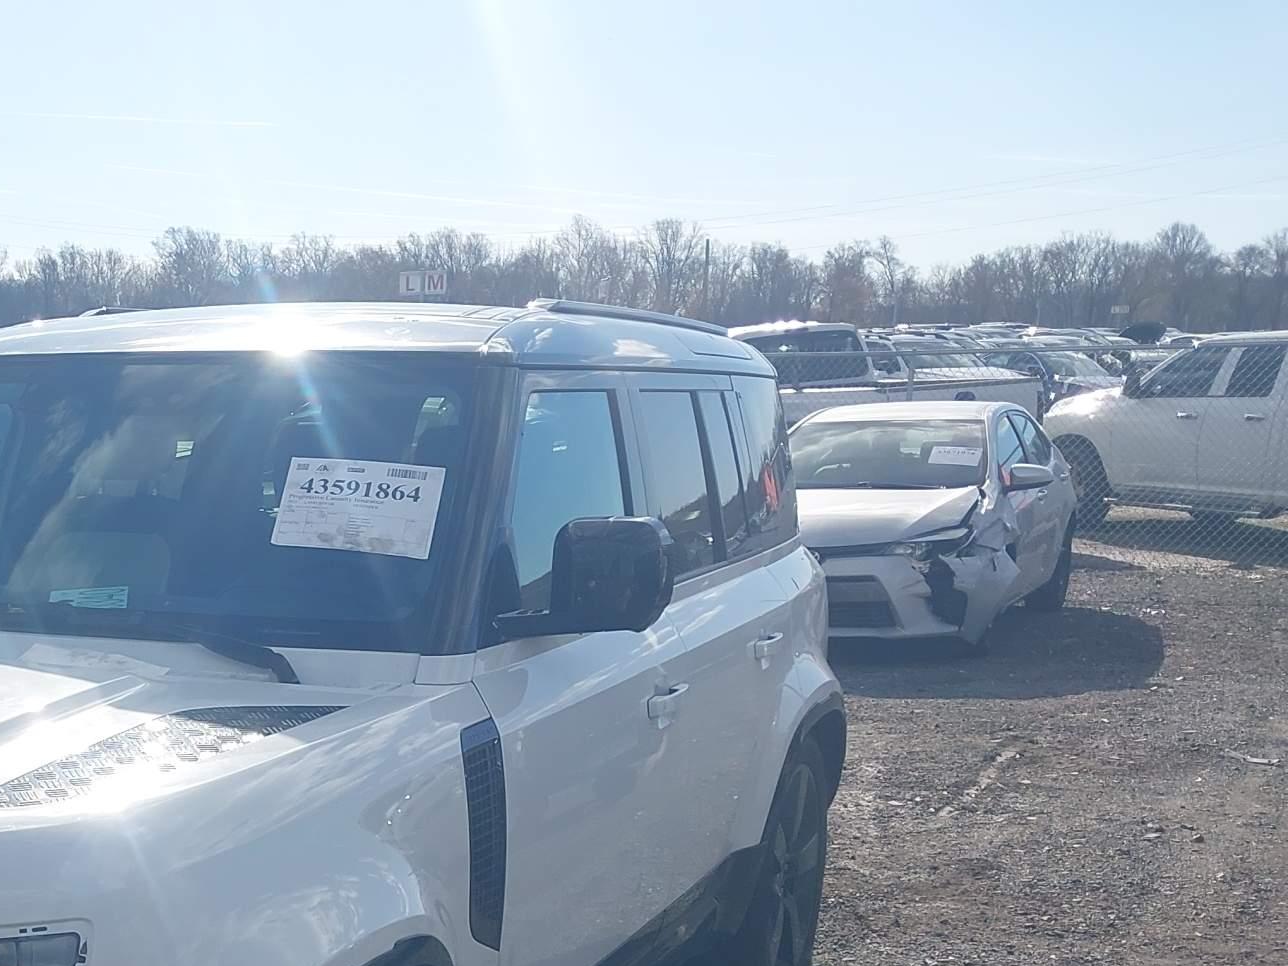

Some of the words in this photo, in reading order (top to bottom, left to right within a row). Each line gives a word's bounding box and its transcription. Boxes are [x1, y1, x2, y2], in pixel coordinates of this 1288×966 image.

[406, 275, 415, 291] L
[427, 274, 444, 291] M
[300, 477, 421, 503] 43591864
